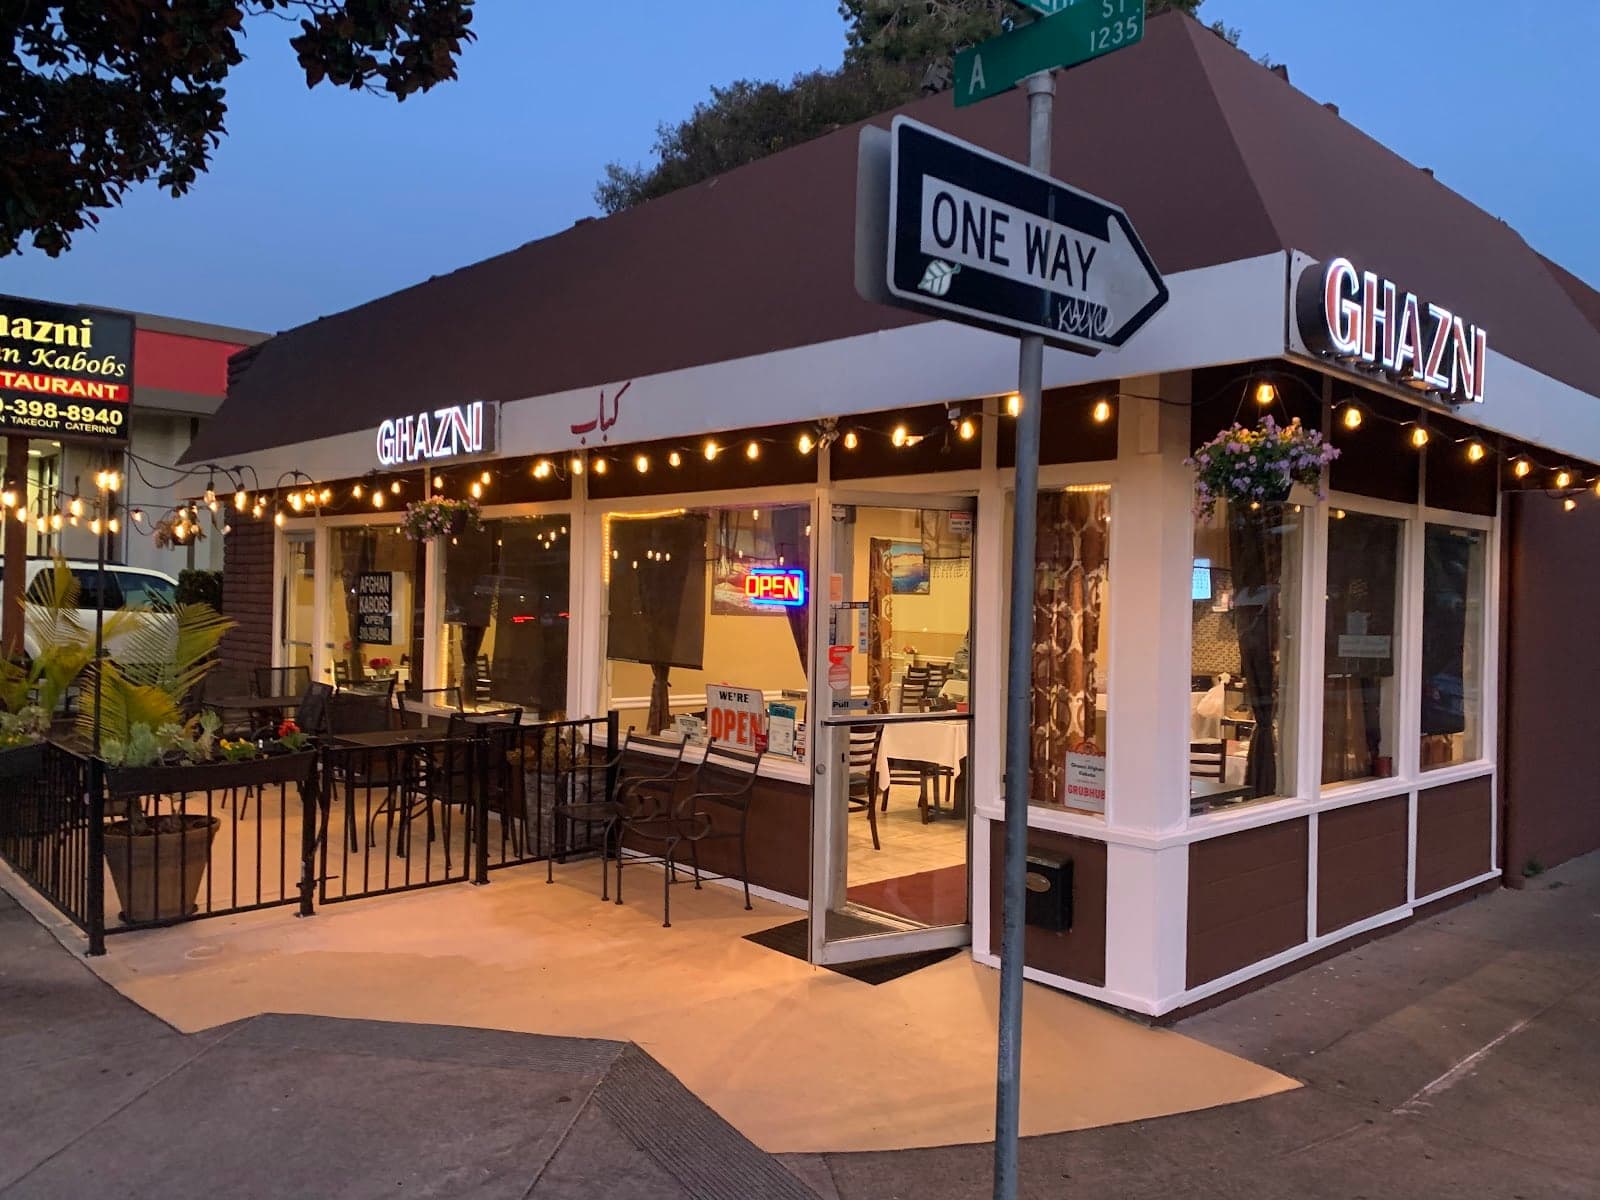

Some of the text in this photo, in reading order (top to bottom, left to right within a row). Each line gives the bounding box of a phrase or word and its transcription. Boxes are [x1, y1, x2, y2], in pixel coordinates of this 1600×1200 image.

[1090, 16, 1138, 52] 1235
[968, 53, 986, 95] A
[931, 191, 1097, 291] ONE WAY
[1324, 257, 1487, 403] GHAZNI
[28, 348, 126, 377] Kabobs
[11, 416, 60, 429] TAKEOUT
[65, 422, 117, 435] CATERING
[376, 401, 483, 466] GHAZNI
[360, 575, 390, 594] AFGHAN
[745, 575, 799, 599] OPEN
[359, 595, 390, 614] KABOBS
[719, 690, 750, 704] WE'RE
[710, 706, 763, 746] OPEN
[1068, 784, 1105, 800] GRUBHUB
